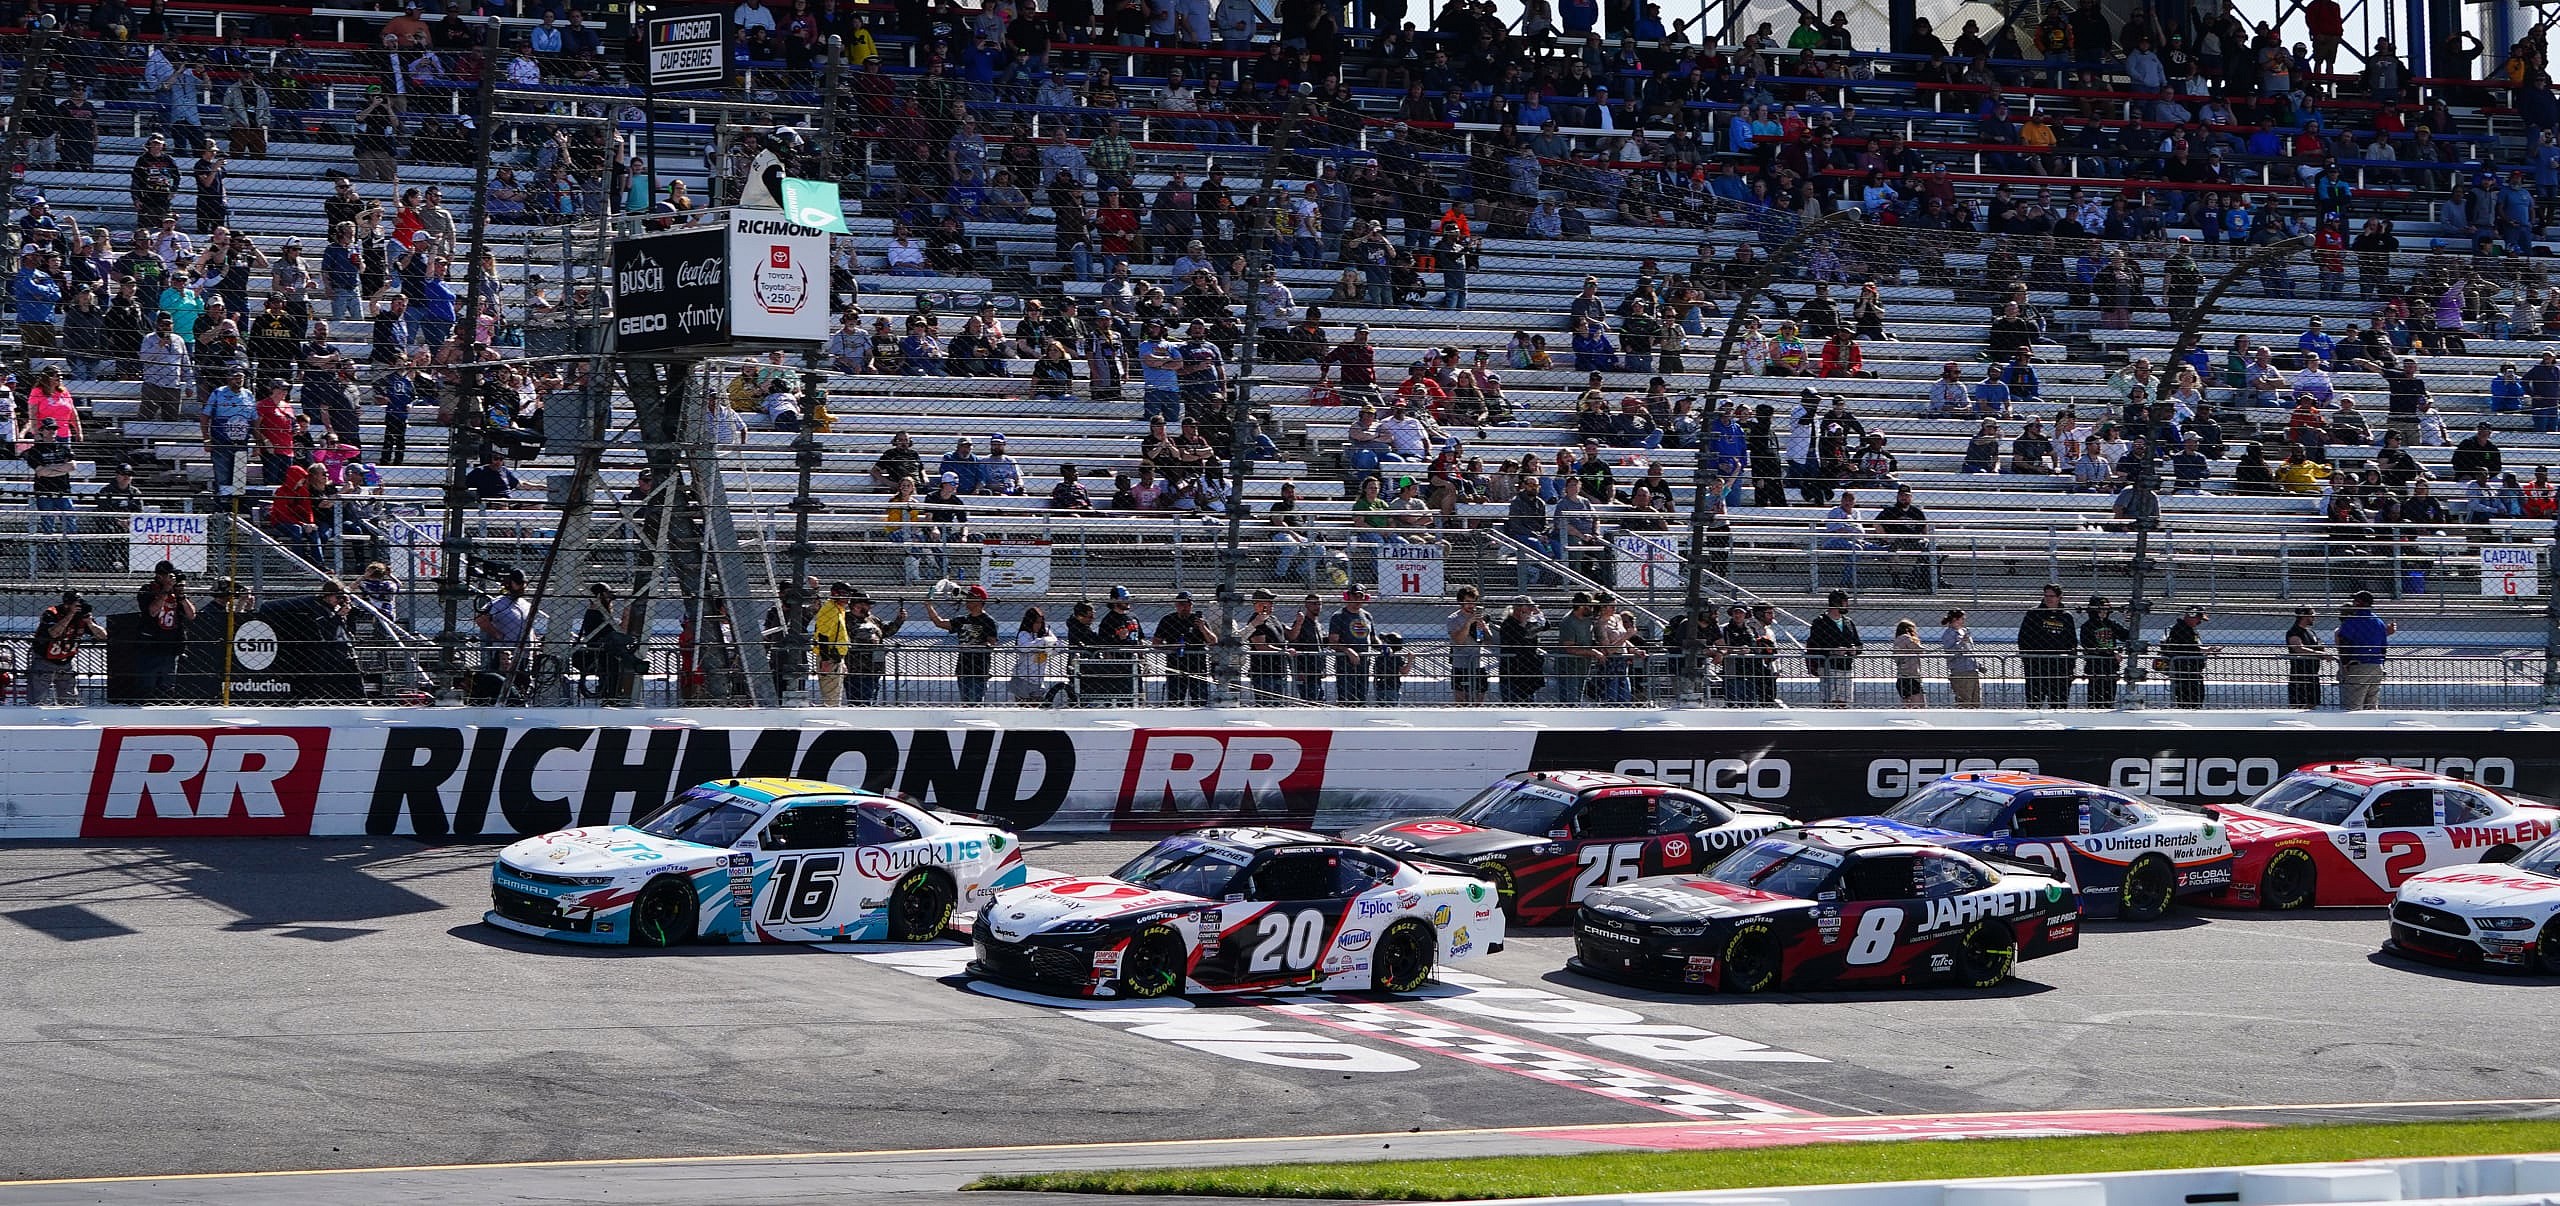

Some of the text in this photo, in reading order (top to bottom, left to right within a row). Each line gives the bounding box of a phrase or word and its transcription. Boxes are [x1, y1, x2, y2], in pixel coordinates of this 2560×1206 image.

[672, 20, 712, 42] NASCAR
[660, 49, 713, 69] CUP SERIES
[737, 219, 823, 237] RICHMOND
[619, 265, 663, 296] BUSCH
[768, 272, 794, 280] TOYOTA
[761, 282, 801, 292] ToyotaCare
[770, 294, 791, 304] 250
[619, 314, 667, 335] GEICO
[677, 303, 725, 334] xfinity
[262, 328, 292, 338] IOWA
[134, 517, 203, 534] CAPITAL
[147, 534, 191, 544] SECTION
[1618, 539, 1675, 553] CAPTAL
[1383, 547, 1435, 559] CAPITAL
[2483, 550, 2534, 564] CAPITAL
[1395, 563, 1428, 571] SECTION
[1402, 573, 1420, 593] H
[2503, 573, 2517, 595] G
[238, 639, 274, 652] csm
[102, 735, 300, 819] RR
[363, 727, 1077, 836] RICHMOND
[1152, 736, 1303, 822] RR
[2111, 757, 2279, 798] GEICO
[2105, 832, 2198, 851] United Rentals
[2444, 819, 2552, 850] WHELEN
[1468, 852, 1508, 864] GOODYEAR
[2174, 845, 2223, 859] Work United
[2378, 831, 2427, 889] 2
[645, 863, 689, 877] GOODYEAR
[1570, 841, 1645, 903] 26
[2189, 868, 2231, 880] GLOBAL
[497, 876, 549, 895] CAMARO
[763, 851, 845, 926] 16
[2189, 877, 2231, 886] INDUSTRIAL
[1136, 911, 1178, 924] GOODYEAR
[1359, 899, 1393, 919] Ziploc
[1434, 907, 1452, 926] all
[1475, 908, 1490, 919] Persil
[1916, 889, 2037, 933] JARRETT
[1391, 923, 1418, 936] EAGLE
[1734, 916, 1774, 927] GOODYEAR
[2046, 918, 2060, 927] TIRE
[1144, 926, 1171, 937] EAGLE
[1337, 930, 1371, 949] Minute
[1584, 924, 1641, 945] CAMARO
[1845, 907, 1905, 965] 8
[1249, 909, 1324, 974] 20
[1450, 941, 1473, 957] Snuggle
[1725, 924, 1768, 963] GOODYEAR
[1930, 953, 1954, 967] Tufco
